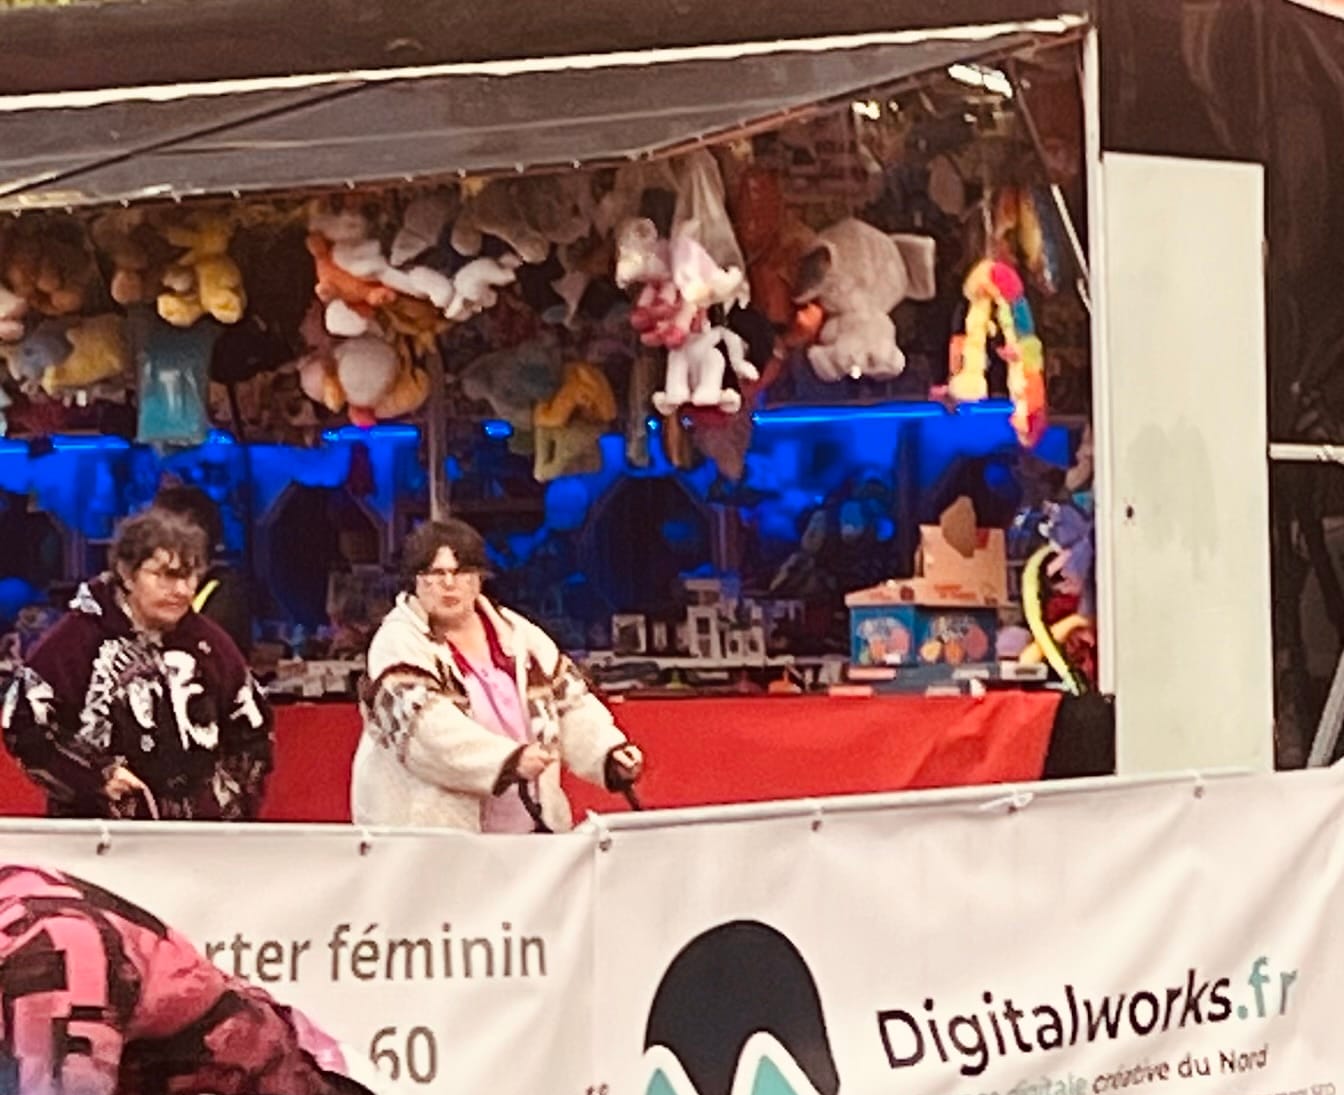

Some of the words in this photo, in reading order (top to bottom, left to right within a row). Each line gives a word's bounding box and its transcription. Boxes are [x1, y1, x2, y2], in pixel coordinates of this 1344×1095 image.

[328, 922, 549, 982] féminin
[877, 955, 1298, 1077] Digitalworks.fr
[369, 1025, 438, 1085] 60
[1177, 1053, 1211, 1079] du
[1219, 1042, 1269, 1075] Nord
